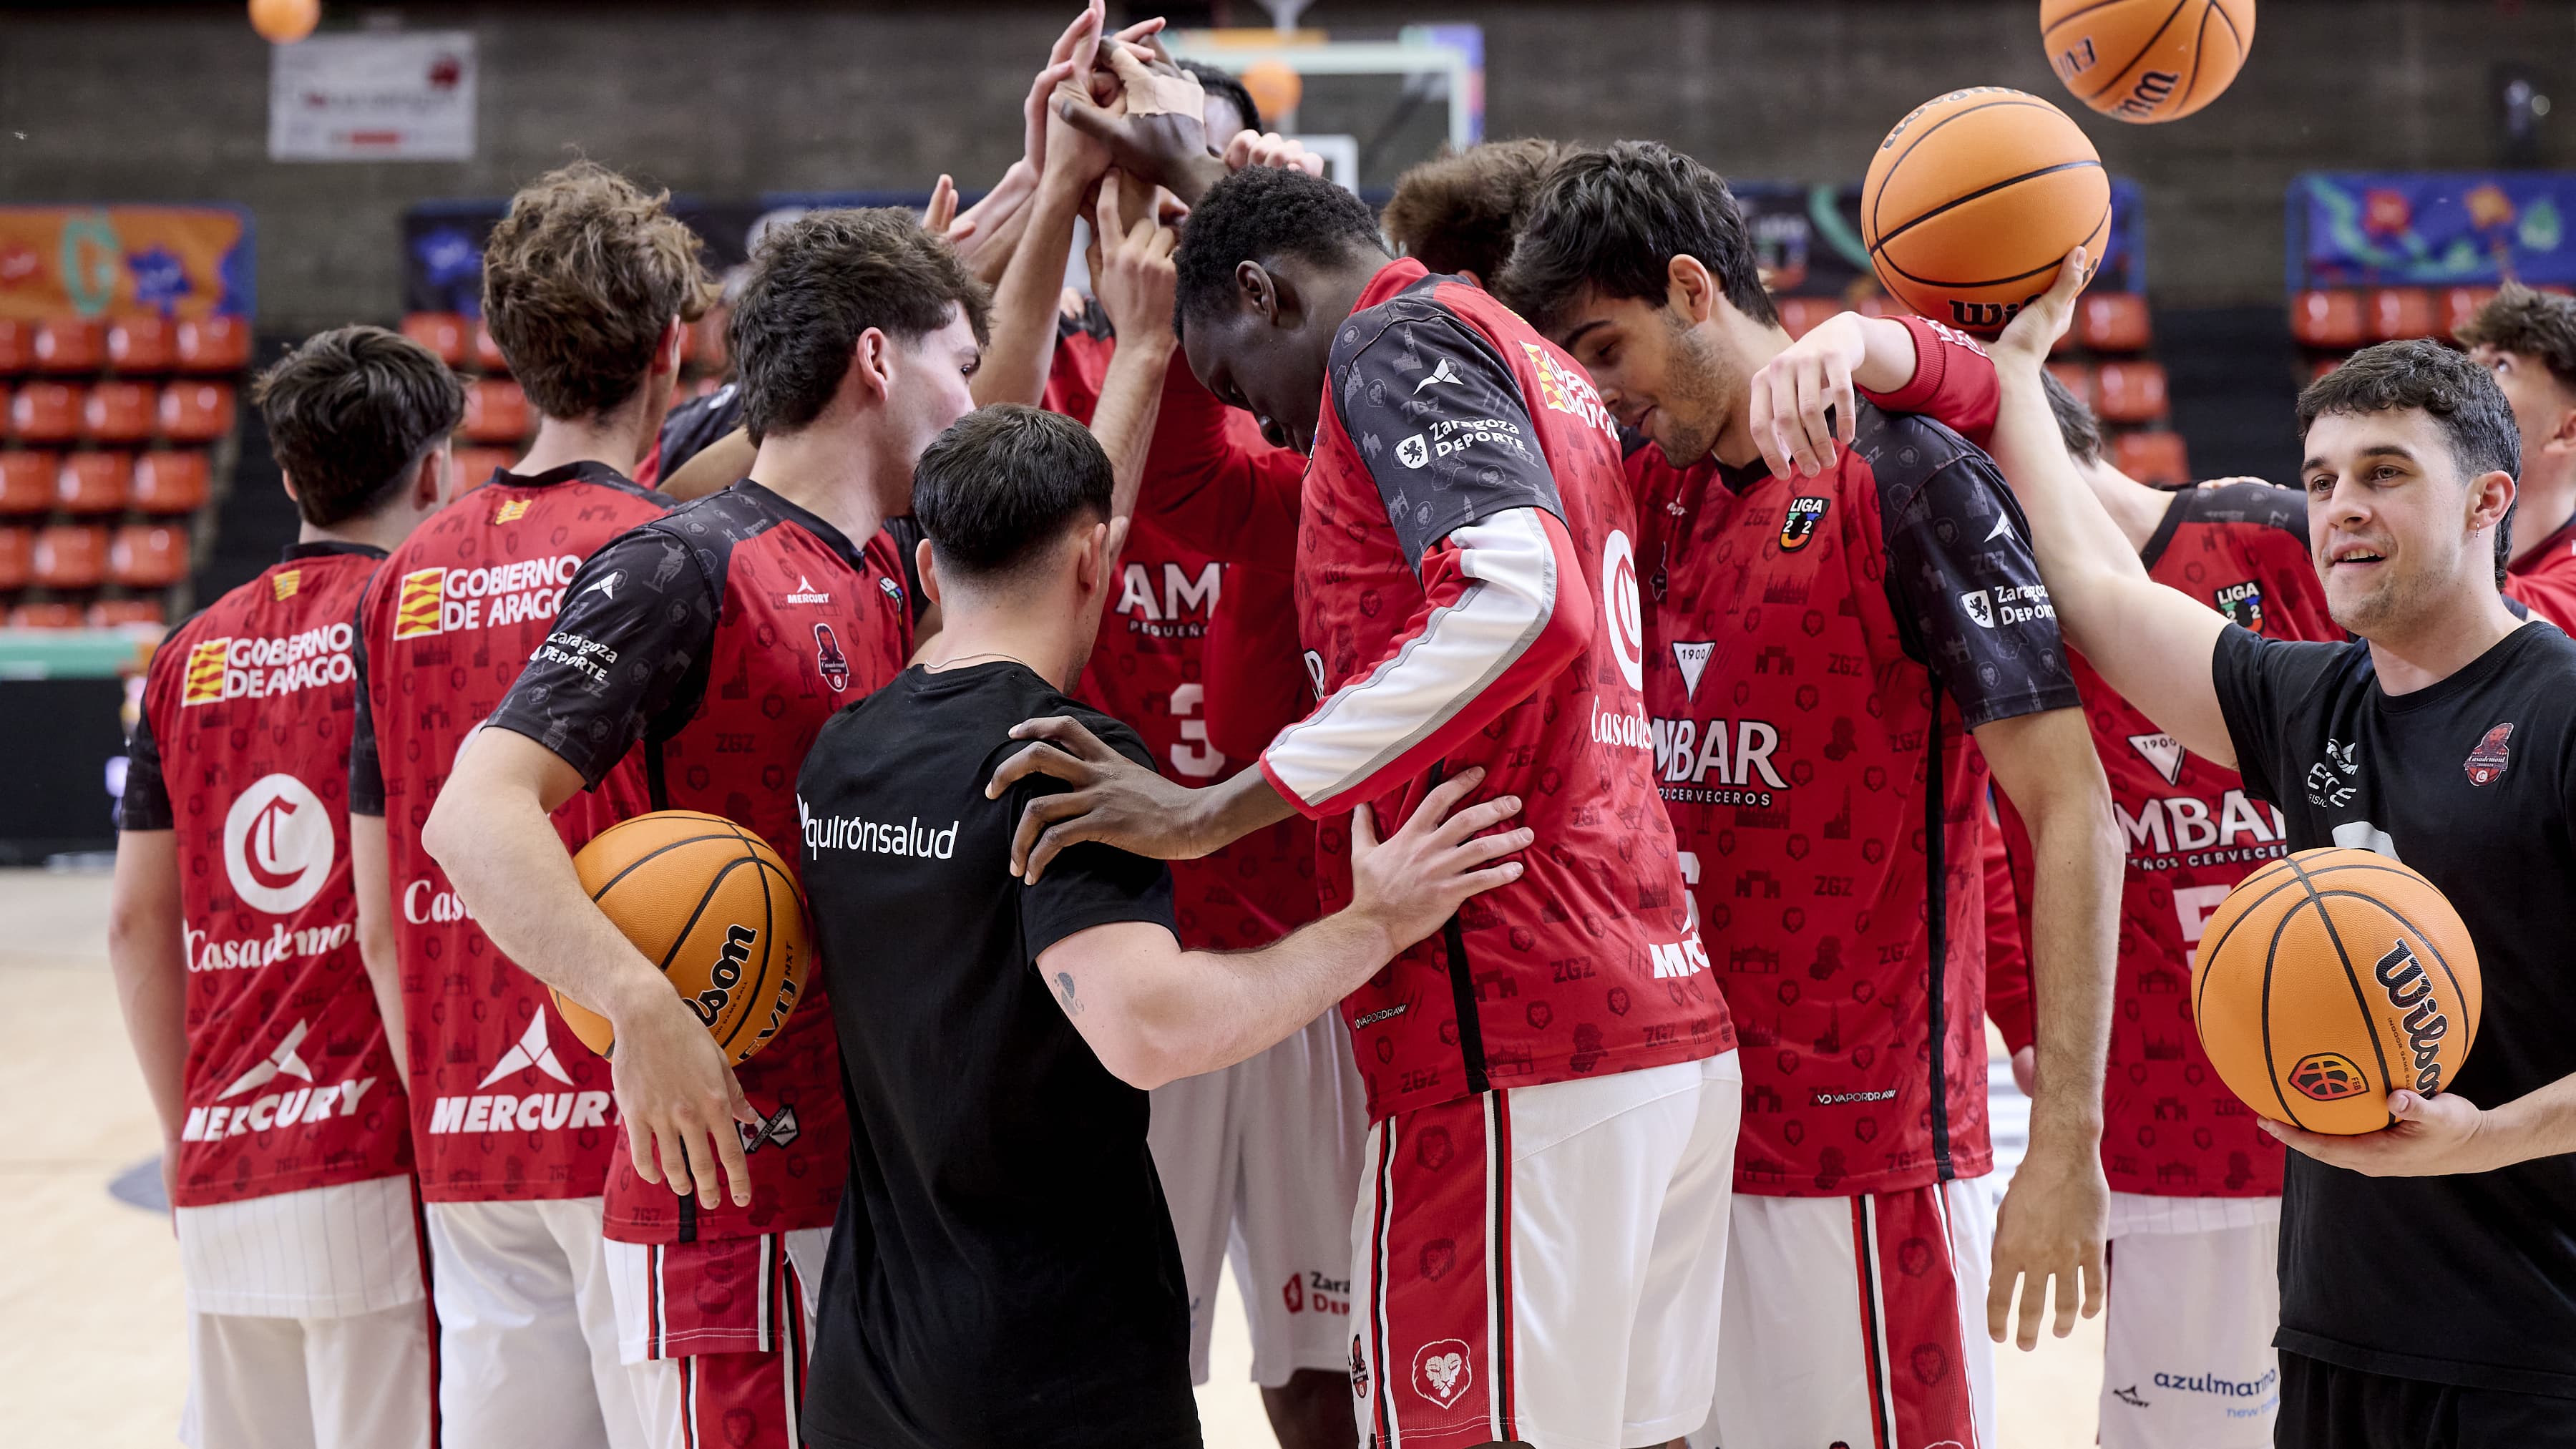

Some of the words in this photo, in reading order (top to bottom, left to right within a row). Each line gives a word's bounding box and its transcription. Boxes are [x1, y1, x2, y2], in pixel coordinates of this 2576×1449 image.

[1428, 419, 1520, 441] Zaragoza
[1435, 431, 1526, 457] DEPORTE
[1790, 498, 1823, 513] LIGA
[787, 593, 829, 604] MERCURY
[1115, 562, 1231, 620] AM
[2218, 582, 2260, 605] LIGA
[443, 600, 482, 631] DE
[1682, 648, 1707, 660] 1900
[226, 669, 263, 698] DE
[1169, 683, 1226, 777] 3
[716, 733, 756, 753] ZGZ
[2142, 738, 2177, 750] 1900
[1672, 790, 1771, 806] CERVECEROS
[805, 815, 960, 861] quirónsalud
[1813, 876, 1854, 897] ZGZ
[183, 917, 360, 972] Casademo
[1550, 955, 1596, 984] ZGZ
[2351, 1076, 2362, 1091] FEB
[1833, 1089, 1896, 1103] VAPORDRAW
[2154, 1368, 2276, 1396] azulmarino
